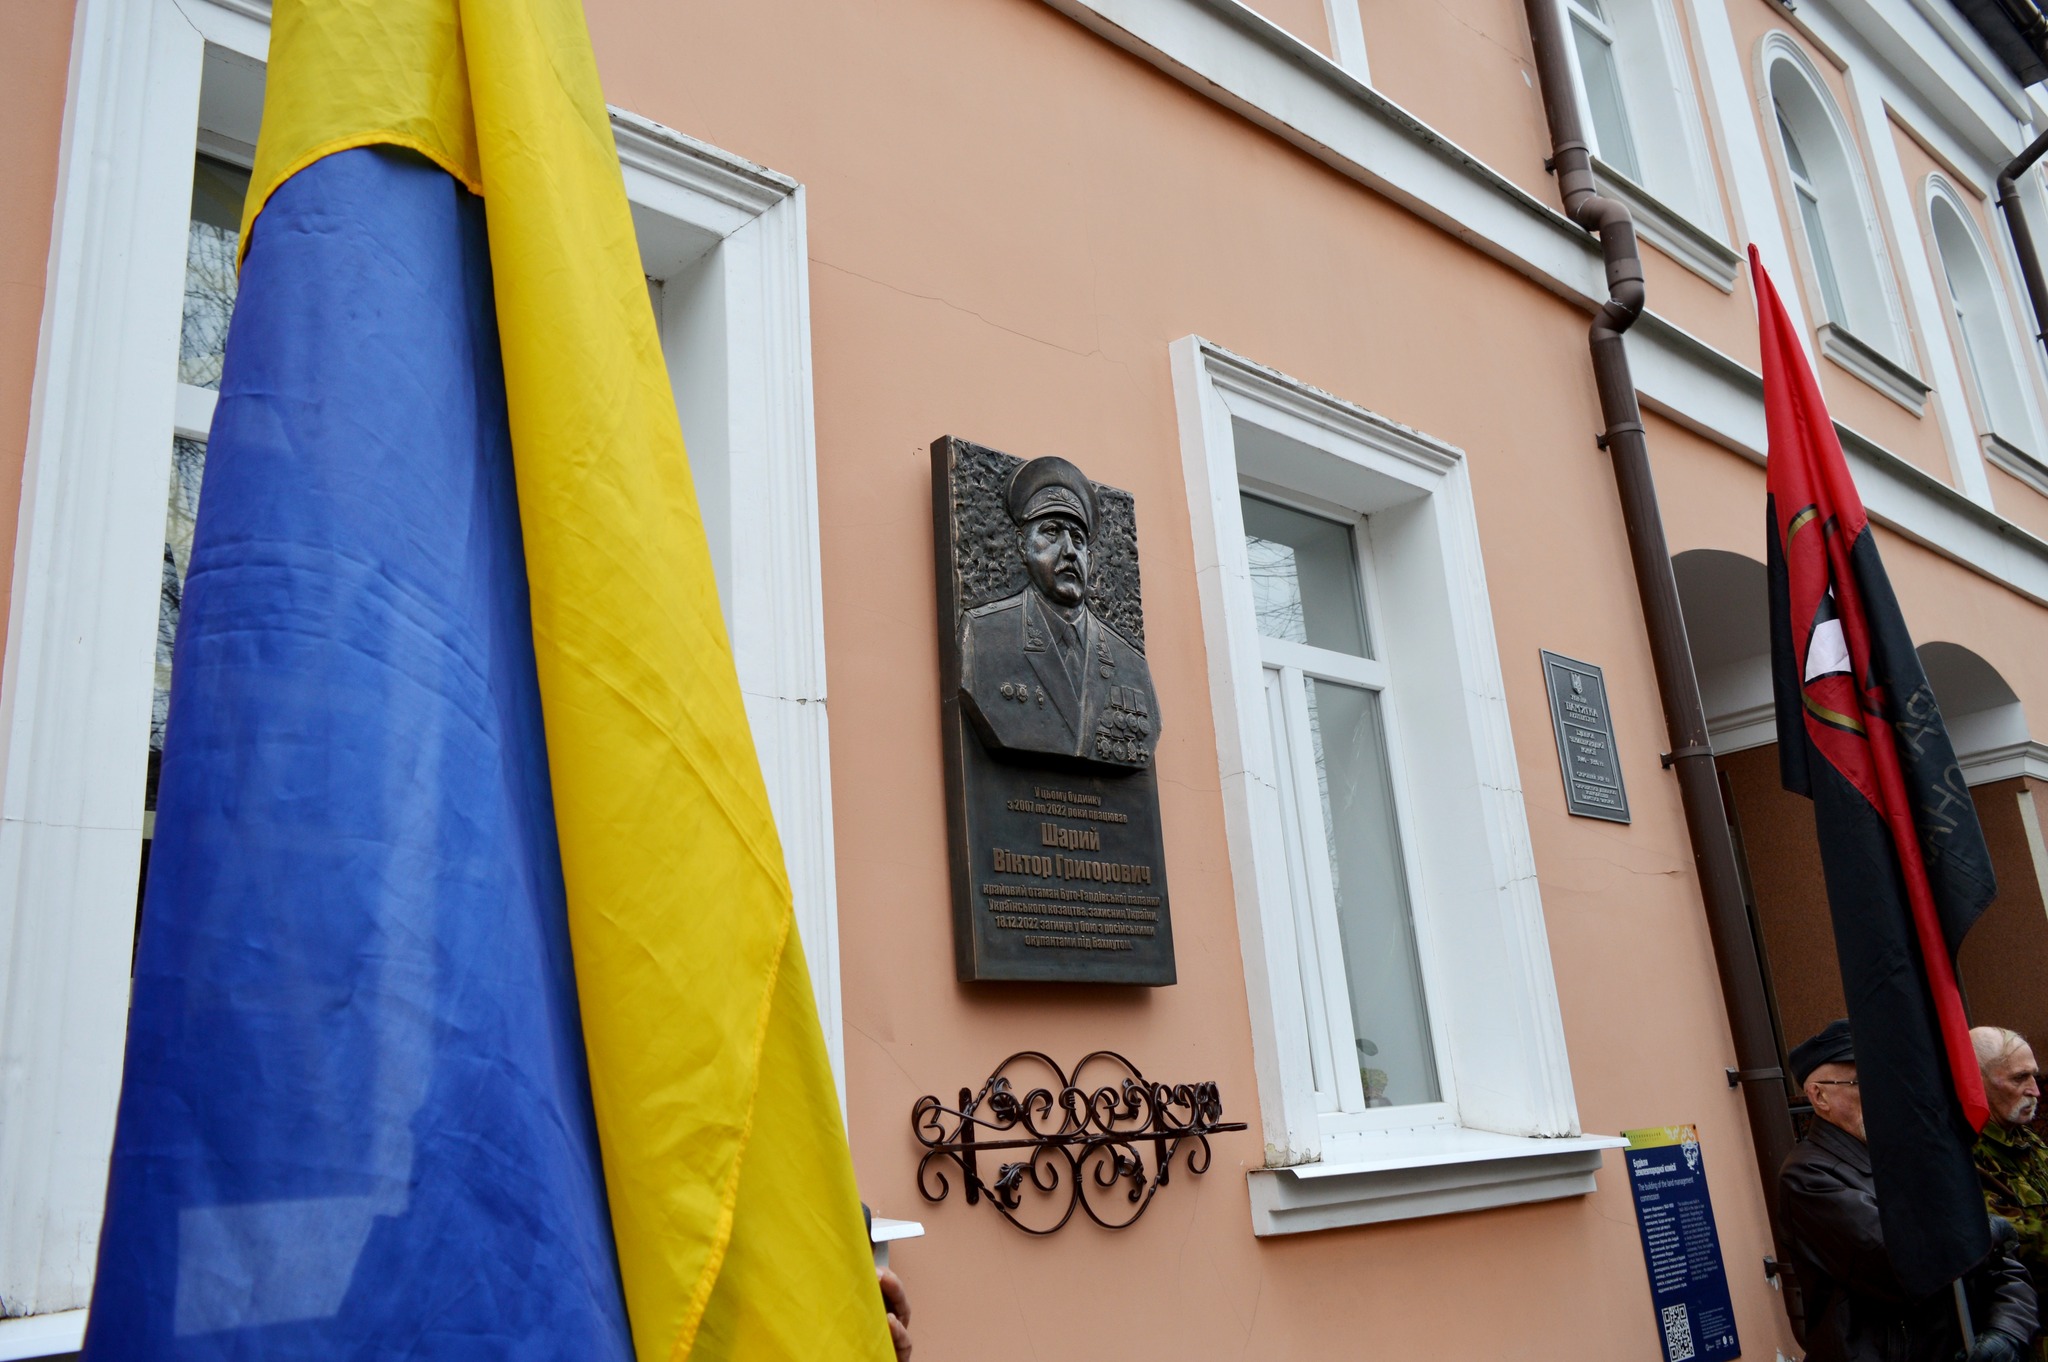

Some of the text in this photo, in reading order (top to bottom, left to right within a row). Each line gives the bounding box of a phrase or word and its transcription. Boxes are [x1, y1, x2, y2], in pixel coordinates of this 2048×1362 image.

[1034, 786, 1102, 806] У цьому будинку
[1014, 800, 1034, 813] 2007
[1035, 804, 1046, 814] по
[1046, 803, 1067, 817] 2022
[1067, 807, 1088, 819] роки
[1088, 810, 1128, 823] працював
[1041, 822, 1100, 851] Шарий
[993, 847, 1151, 885] Віктор Григорович
[983, 883, 1027, 897] крайовий
[1028, 887, 1059, 899] отаман
[1127, 895, 1160, 906] паланки
[988, 899, 1047, 914] Українського
[1088, 908, 1126, 919] захисник
[995, 916, 1039, 931] 18.12.2022
[1040, 920, 1073, 933] загинув
[1073, 922, 1079, 933] у
[1080, 921, 1097, 934] бою
[1104, 921, 1156, 936] російськими
[1025, 935, 1077, 949] окупантами
[1077, 935, 1092, 950] під
